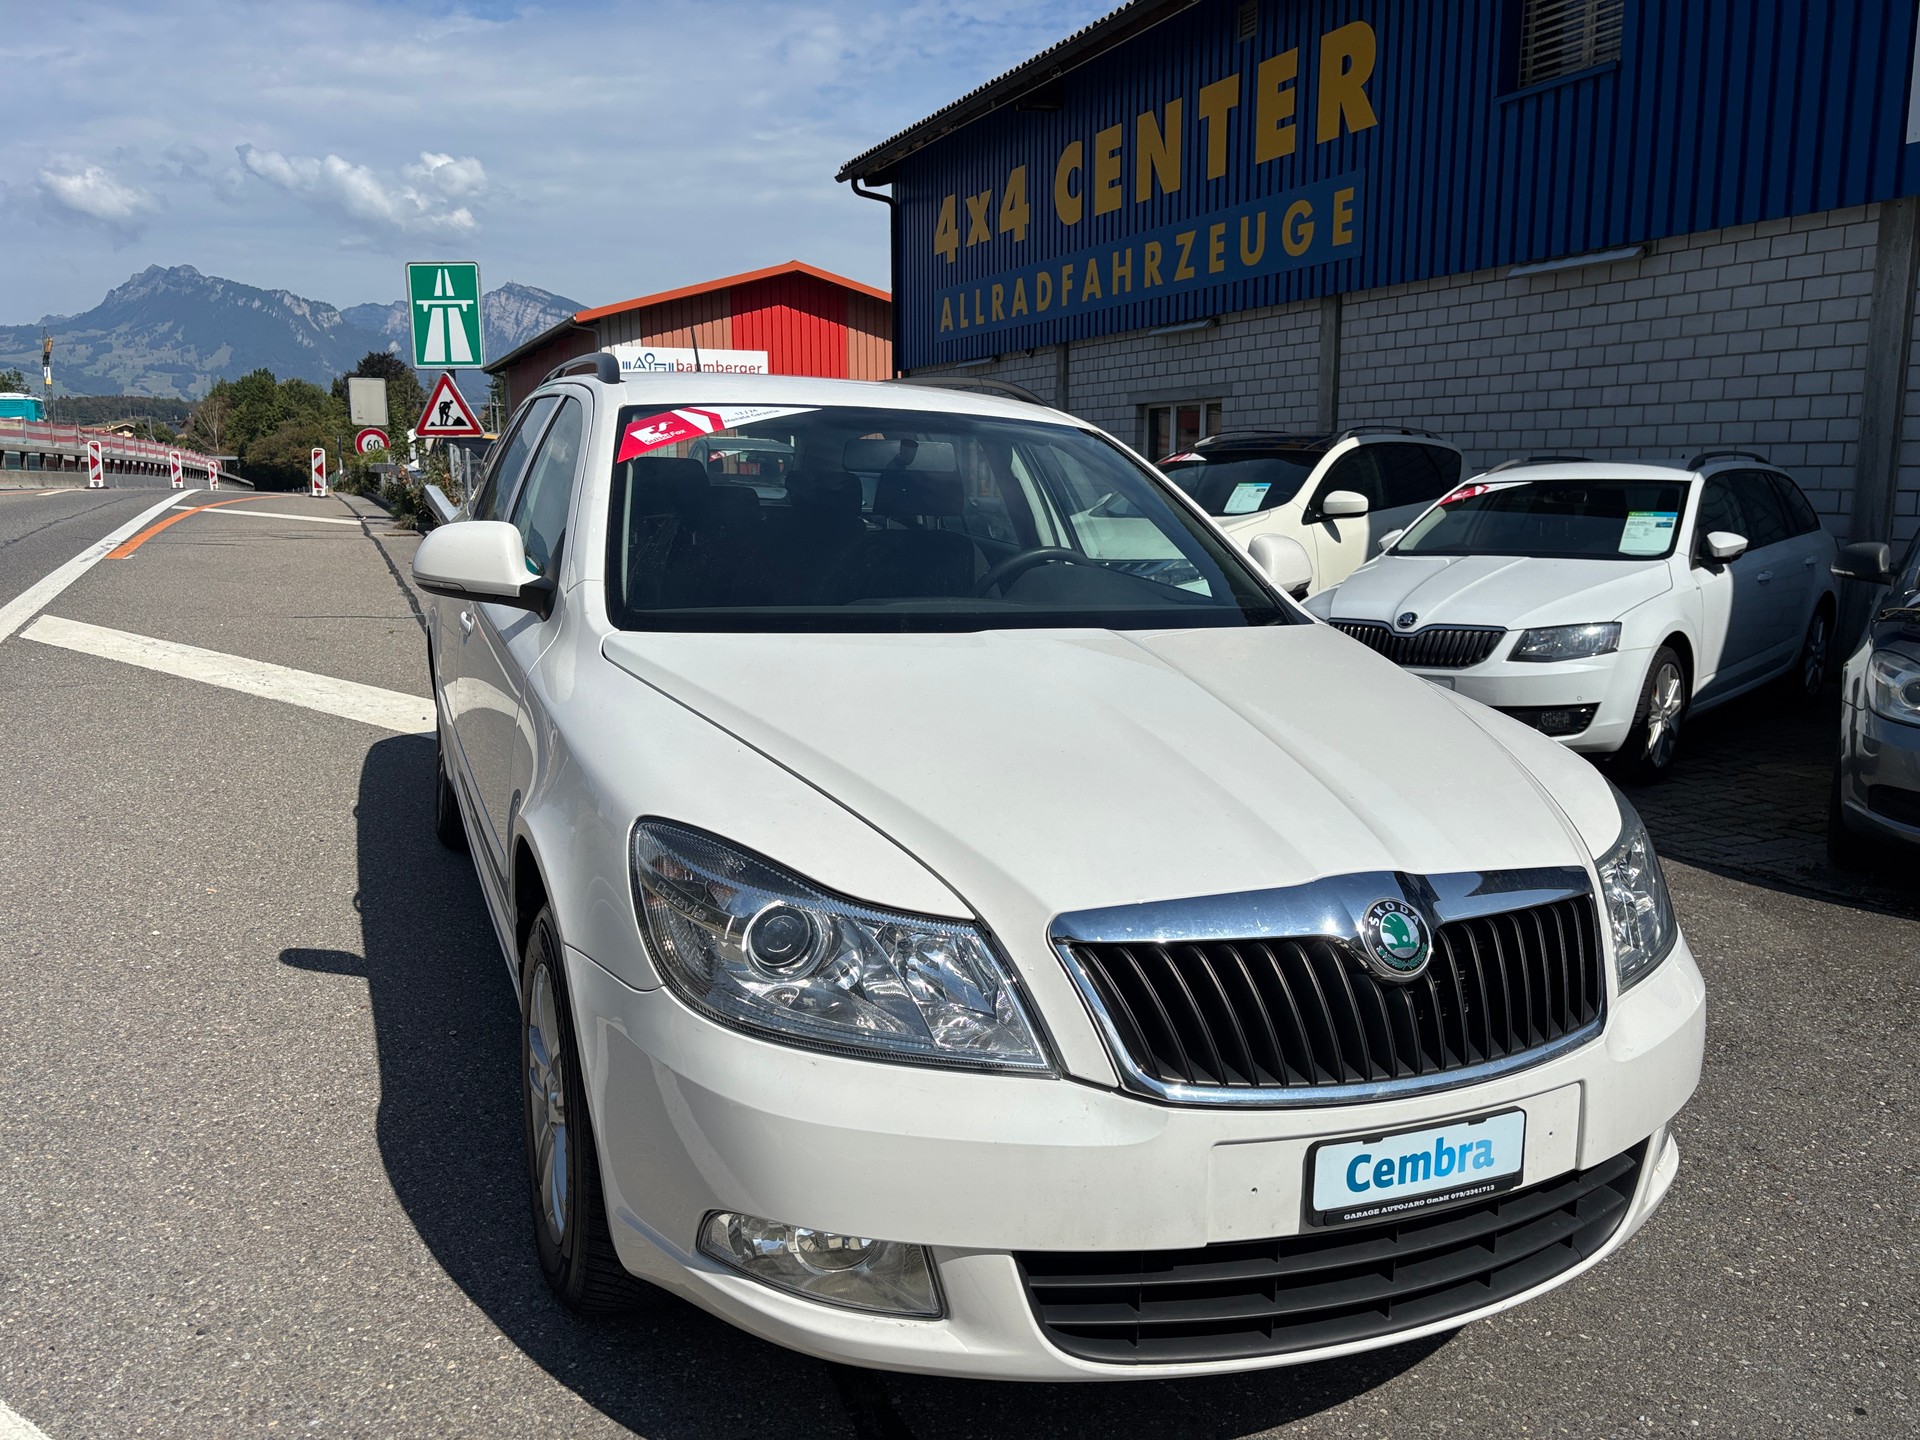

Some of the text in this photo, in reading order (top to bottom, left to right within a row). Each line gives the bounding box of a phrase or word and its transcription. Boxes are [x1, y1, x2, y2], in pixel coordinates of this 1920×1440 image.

[934, 20, 1378, 264] 4x4 CENTER
[939, 186, 1355, 334] ALLRADFAHRZEUGE
[366, 439, 380, 451] 60
[1346, 1137, 1494, 1193] Cembra
[1343, 1208, 1380, 1220] GARAGE
[1381, 1199, 1425, 1213] AUTOJARO
[1426, 1194, 1450, 1205] GmbH
